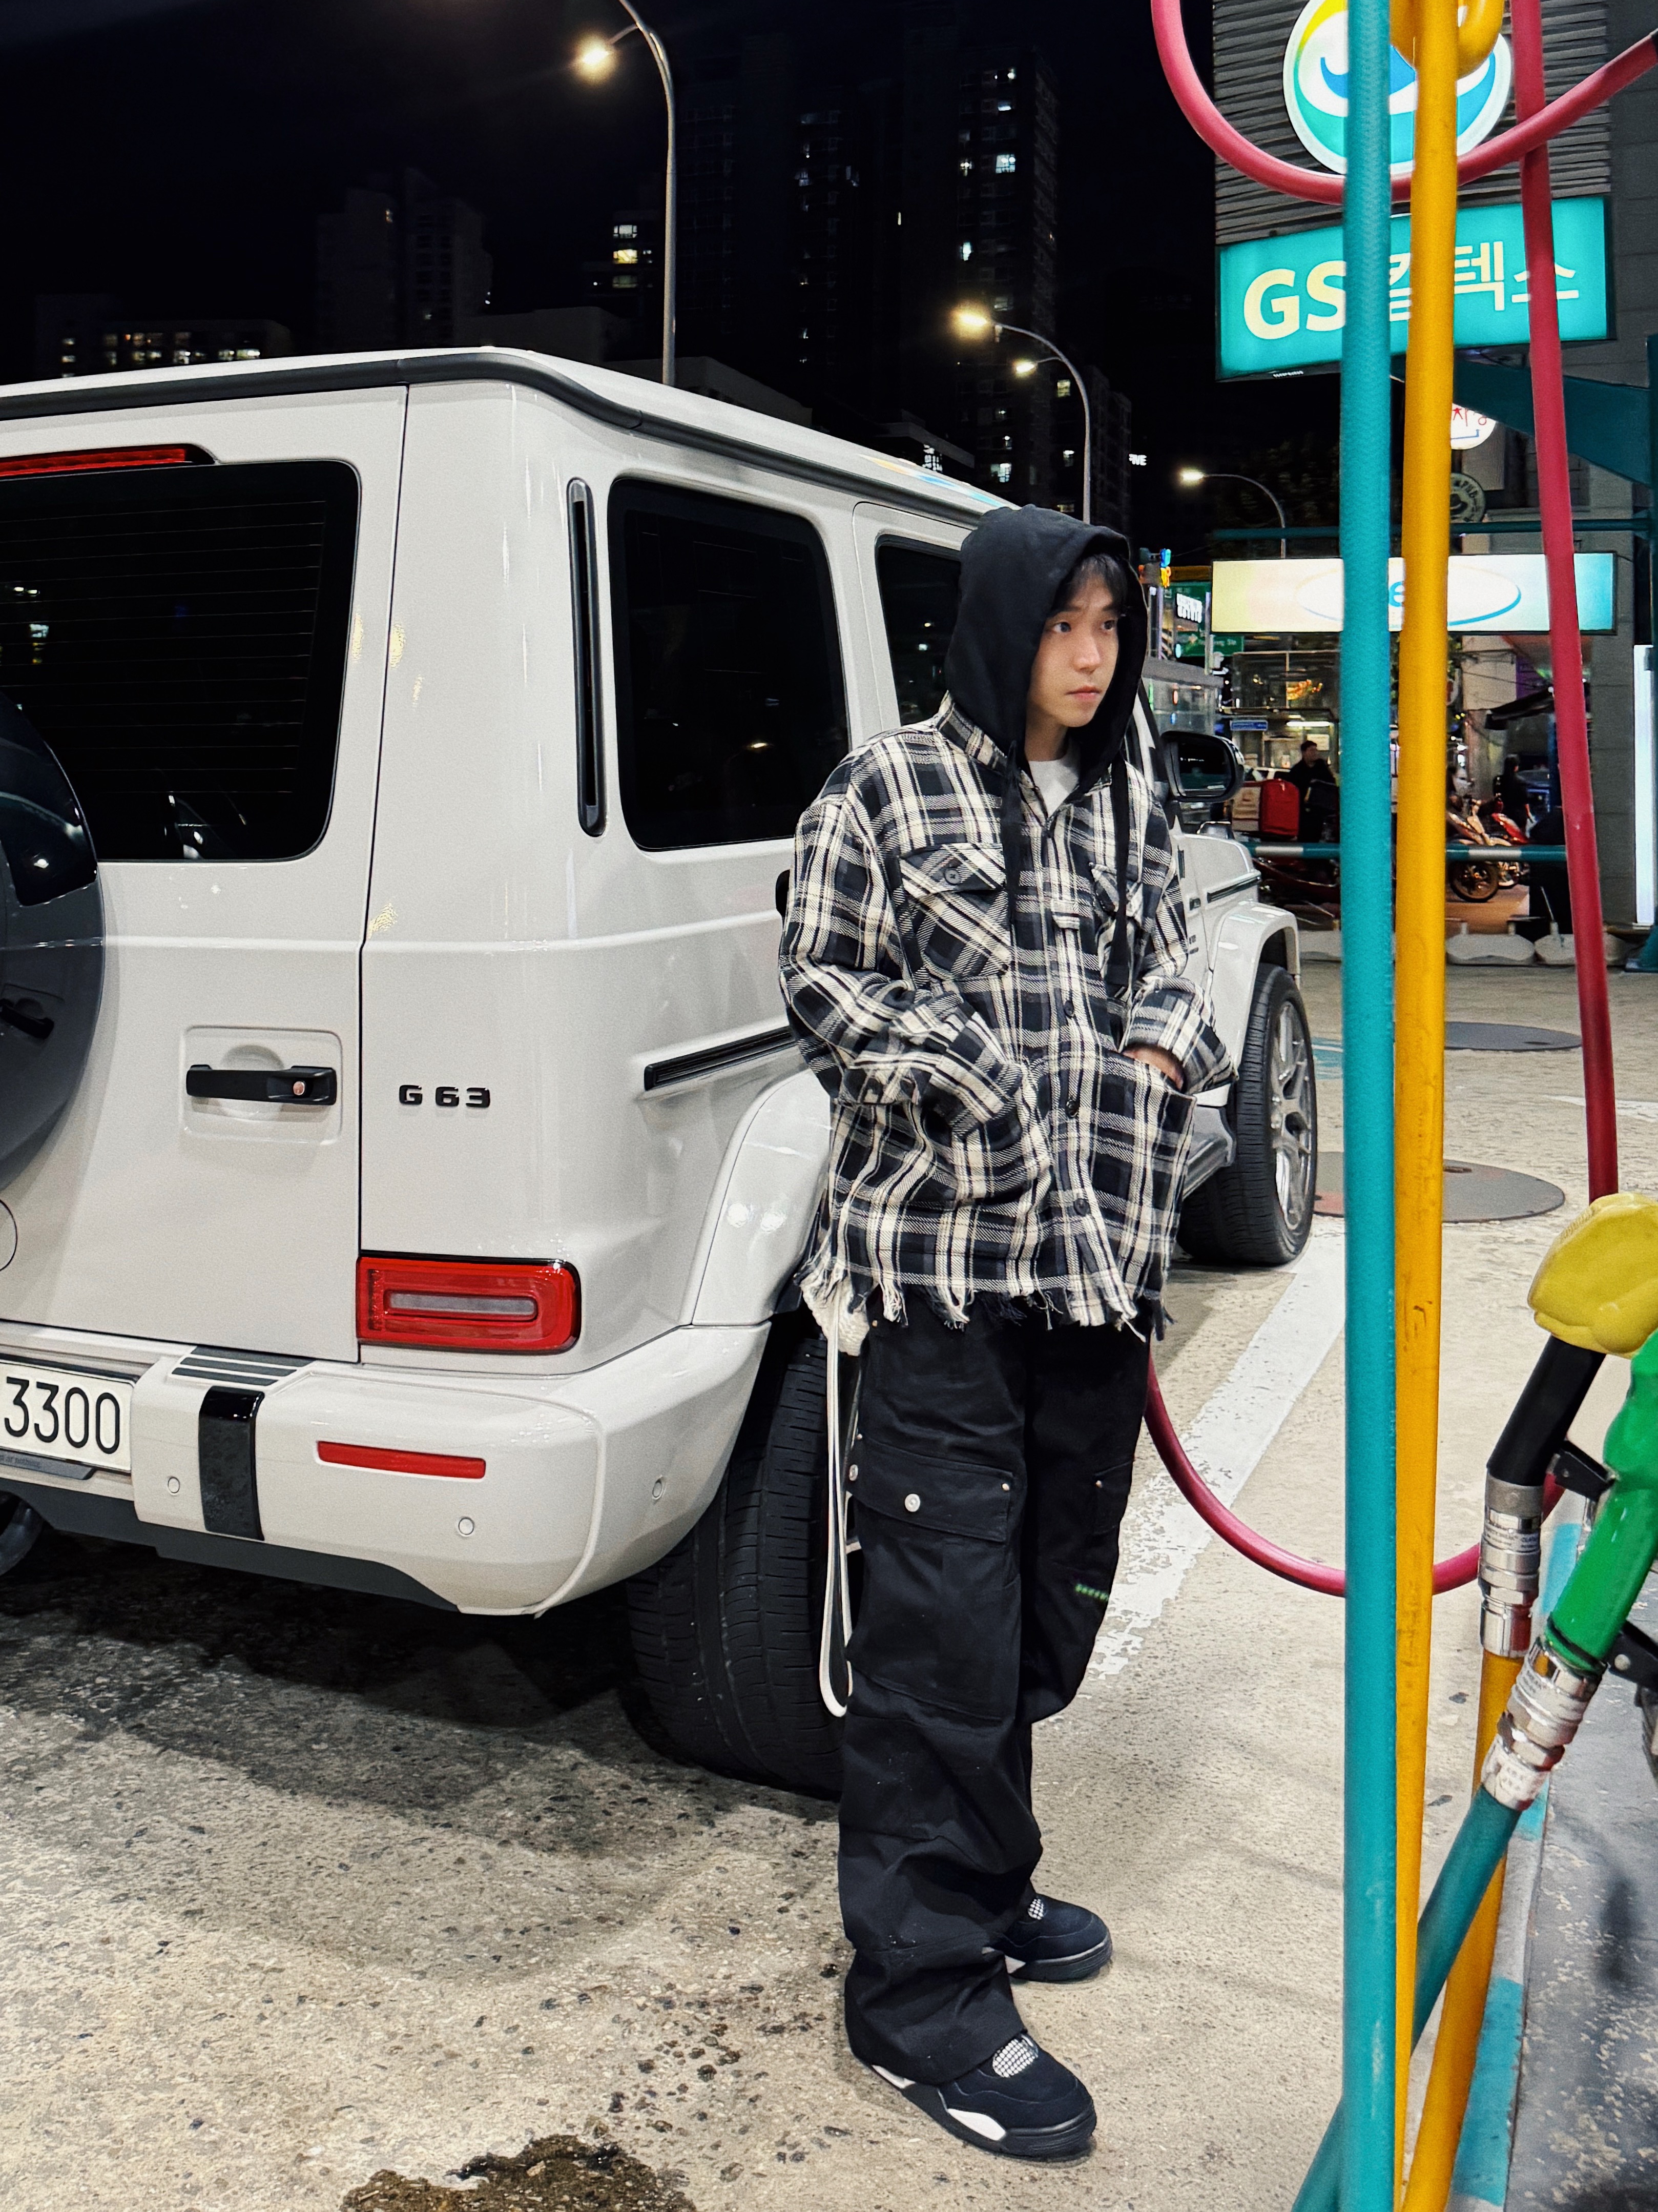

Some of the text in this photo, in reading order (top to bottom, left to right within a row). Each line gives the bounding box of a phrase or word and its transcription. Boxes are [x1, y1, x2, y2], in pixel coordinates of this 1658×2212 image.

[399, 1085, 490, 1108] G 63
[4, 1376, 120, 1455] 3300
